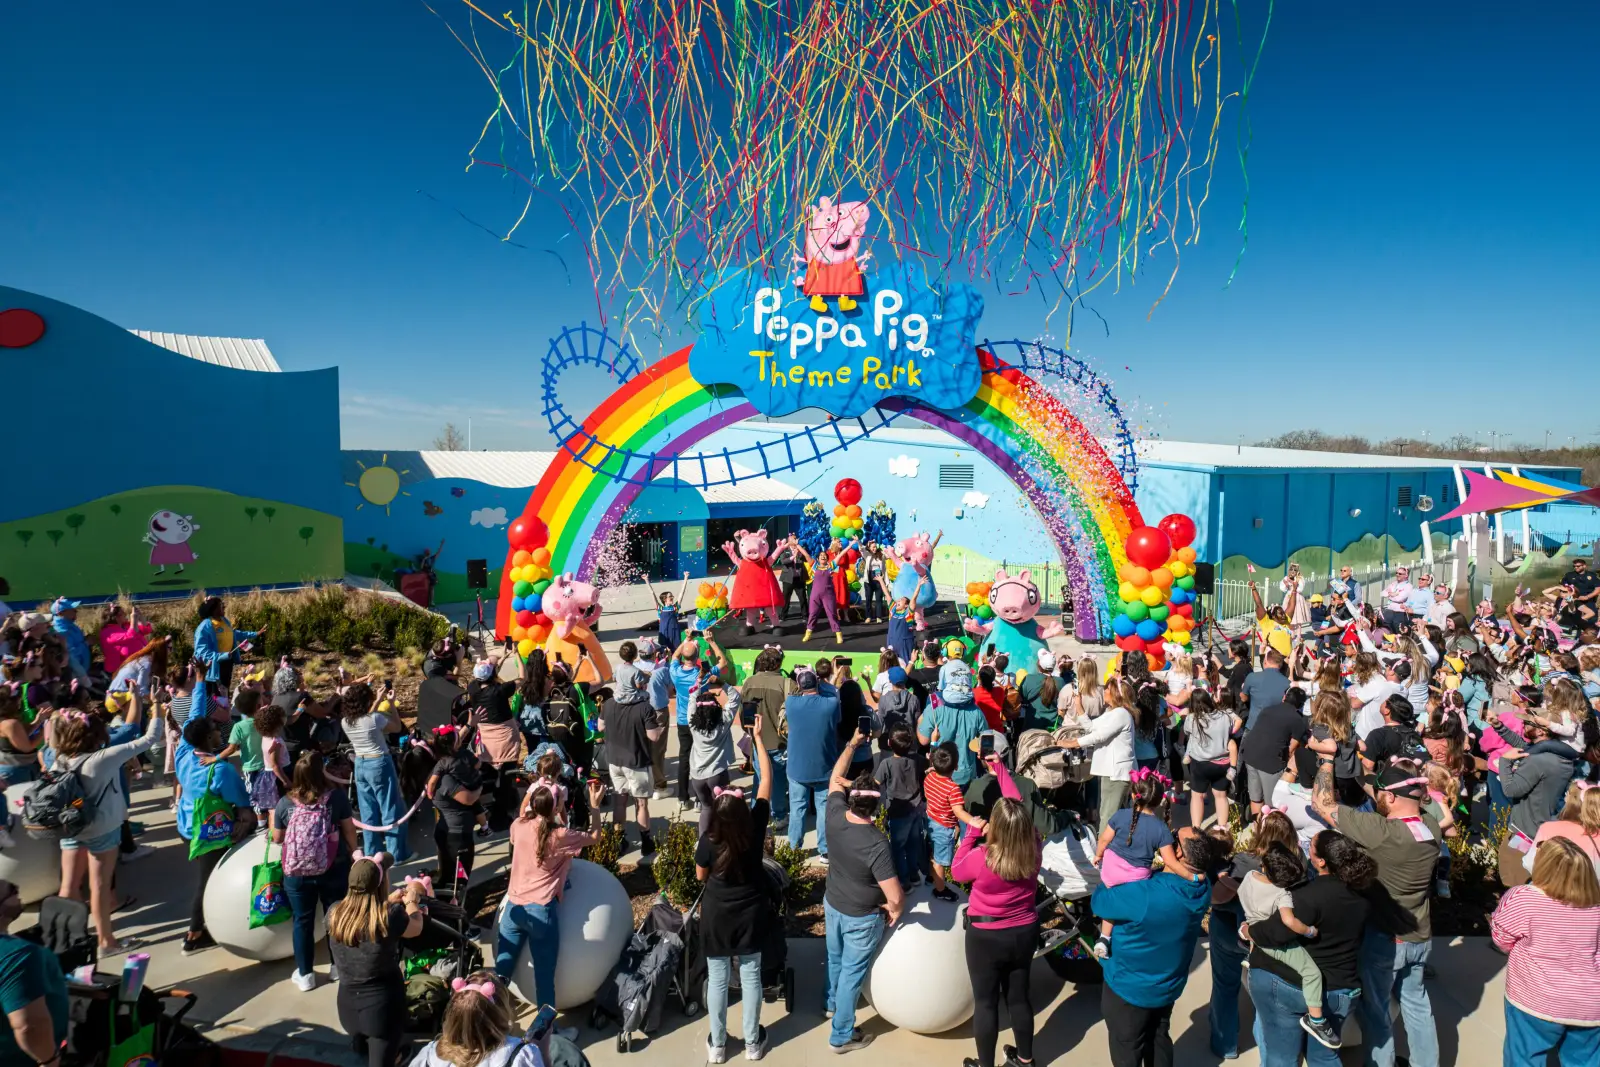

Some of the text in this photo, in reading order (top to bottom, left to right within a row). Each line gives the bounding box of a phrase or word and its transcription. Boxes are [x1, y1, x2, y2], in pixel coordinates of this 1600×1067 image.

[753, 287, 867, 360] Peppa
[874, 289, 935, 358] Pig
[748, 350, 922, 389] Theme Park
